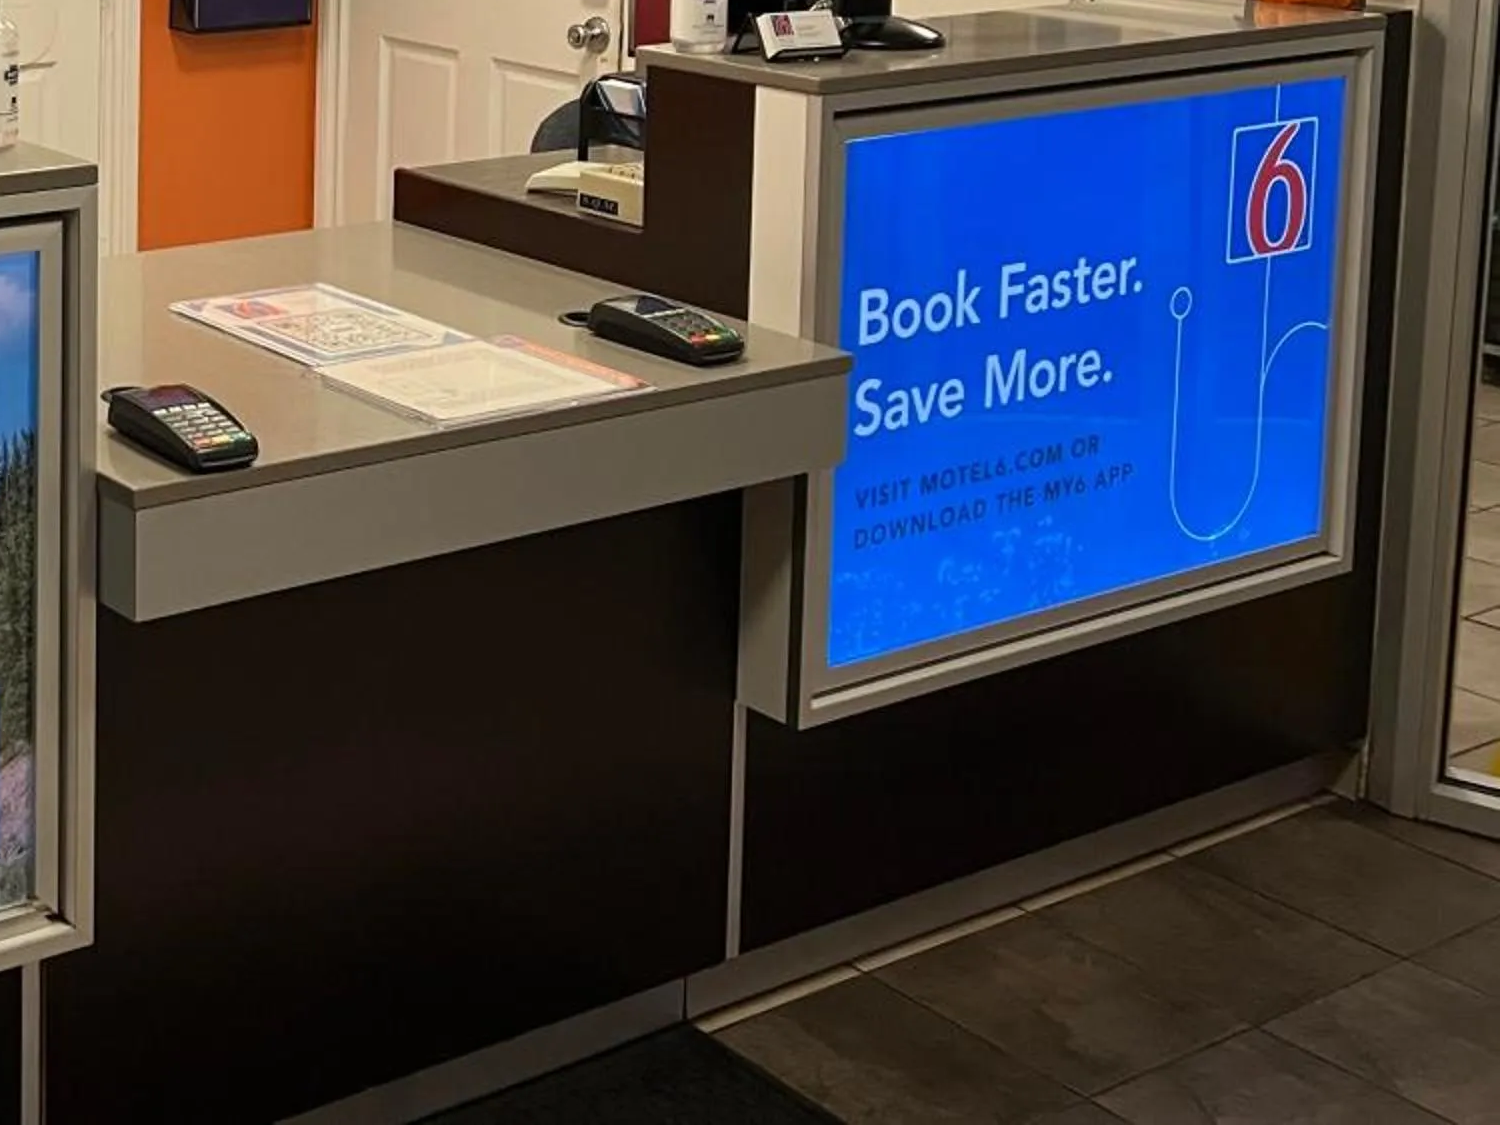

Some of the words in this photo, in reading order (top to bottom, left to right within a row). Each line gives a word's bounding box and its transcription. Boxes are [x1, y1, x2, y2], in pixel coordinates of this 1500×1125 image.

[1246, 121, 1307, 256] 6
[859, 269, 982, 345] Book
[1000, 257, 1143, 318] Faster.
[854, 378, 965, 436] Save
[985, 348, 1112, 408] More.
[854, 478, 911, 509] VISIT
[919, 444, 1062, 496] MOTEL6.COM
[1070, 434, 1100, 458] OR
[854, 498, 988, 550] DOWNLOAD
[996, 489, 1035, 514] THE
[1043, 477, 1086, 503] MY6
[1094, 462, 1134, 490] APP
